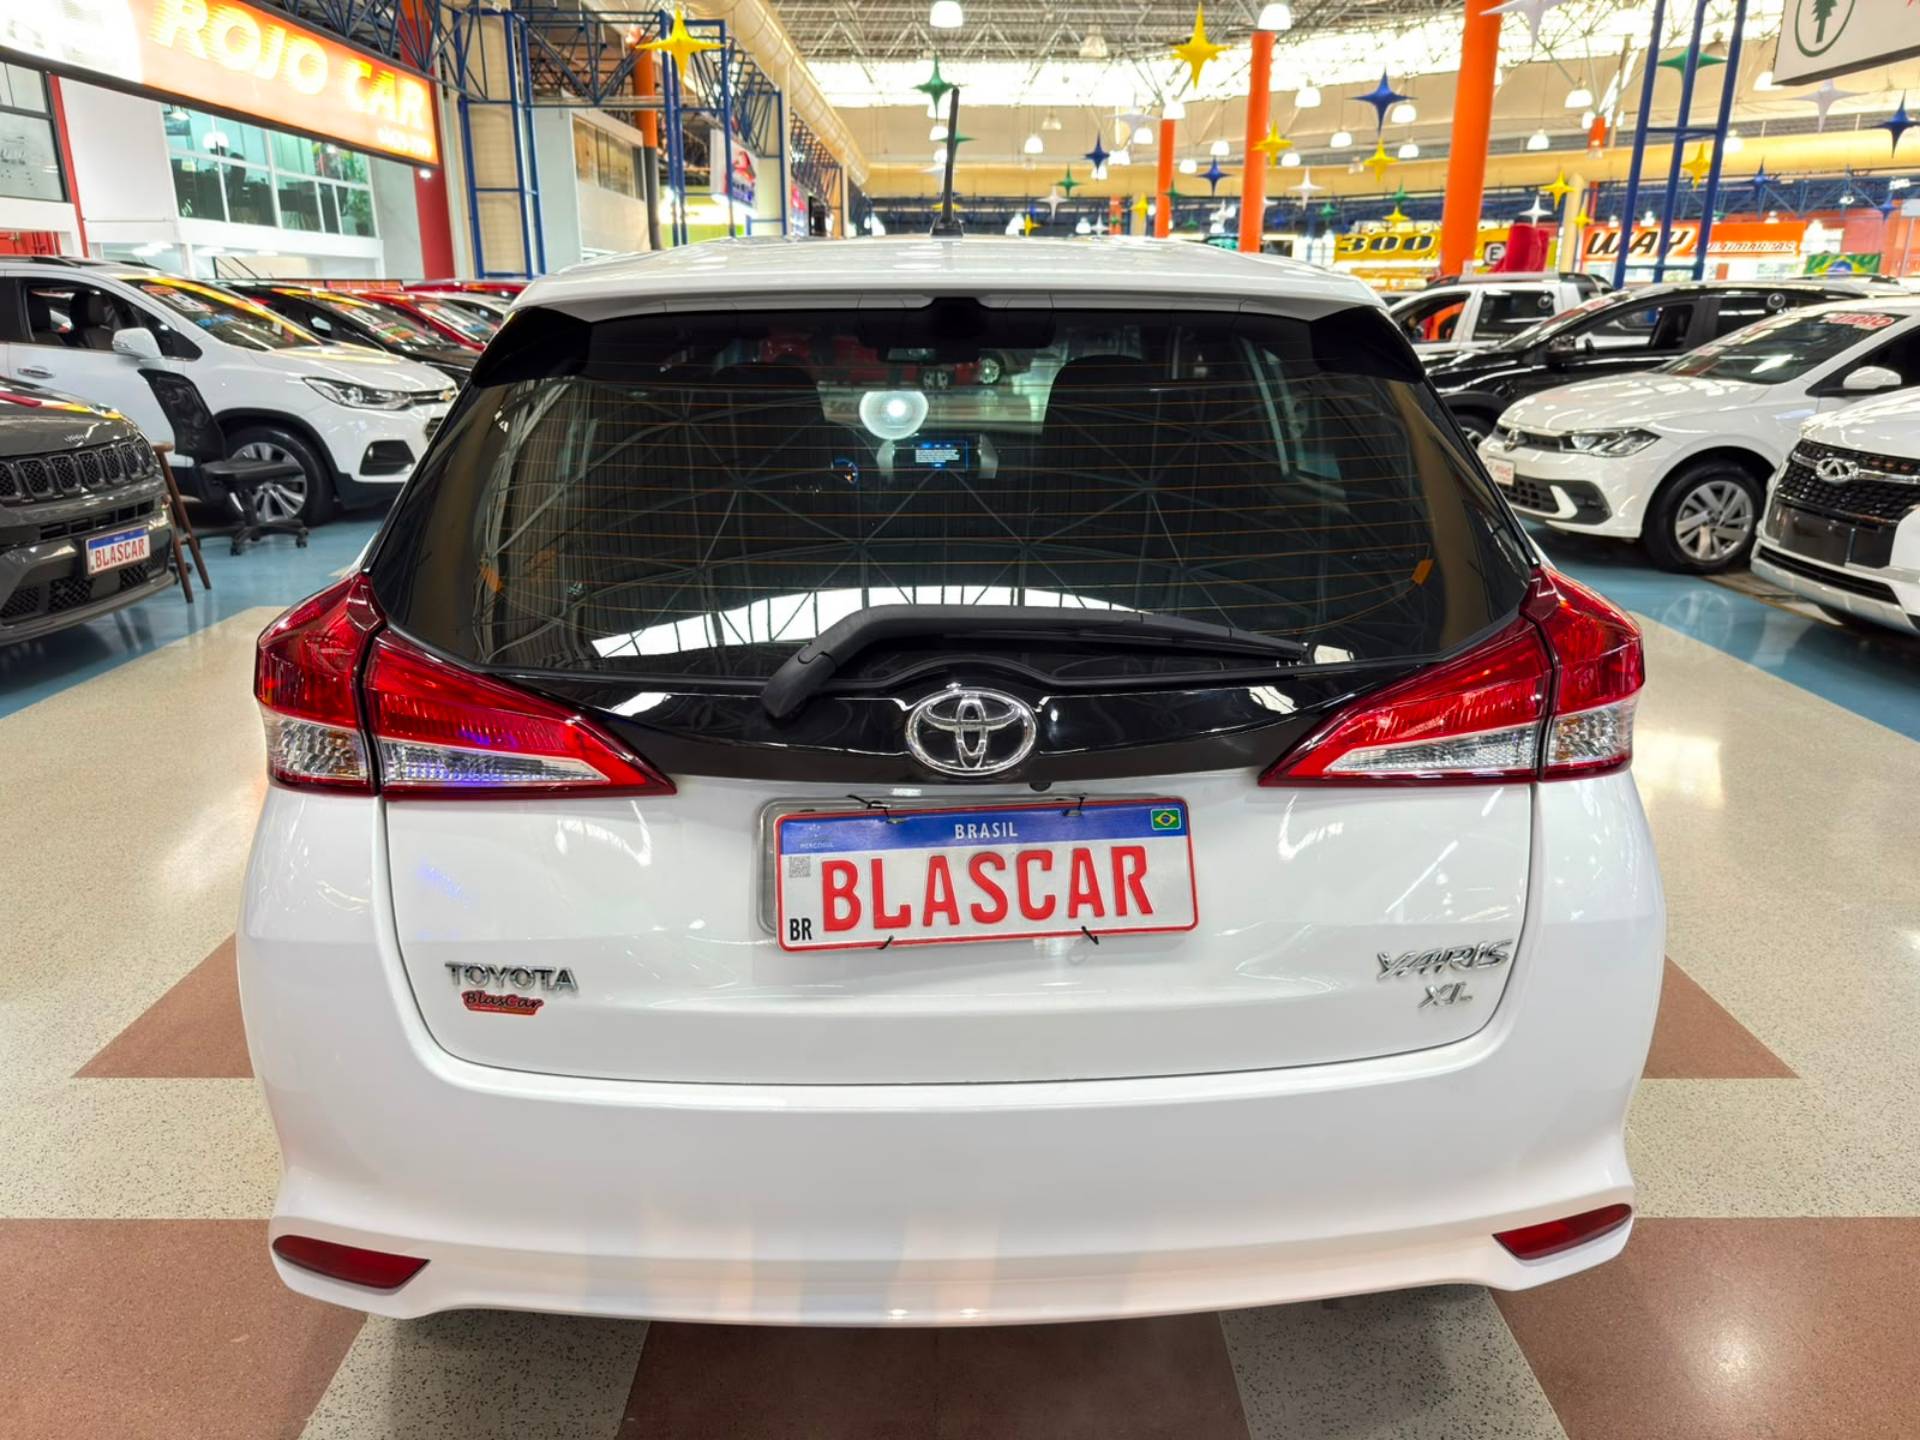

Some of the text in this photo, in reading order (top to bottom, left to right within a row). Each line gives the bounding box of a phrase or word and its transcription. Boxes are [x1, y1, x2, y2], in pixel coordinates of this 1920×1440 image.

[149, 0, 426, 129] ROJO CAR
[1585, 227, 1796, 256] WAY ULTIMARCAS
[95, 538, 145, 569] BLASCAR
[954, 822, 1018, 840] BRASIL
[821, 845, 1153, 932] BLASCAR
[790, 918, 812, 941] BR
[1377, 939, 1512, 978] YARIS
[444, 961, 579, 992] TOYOTA
[464, 990, 543, 1009] BlasCar
